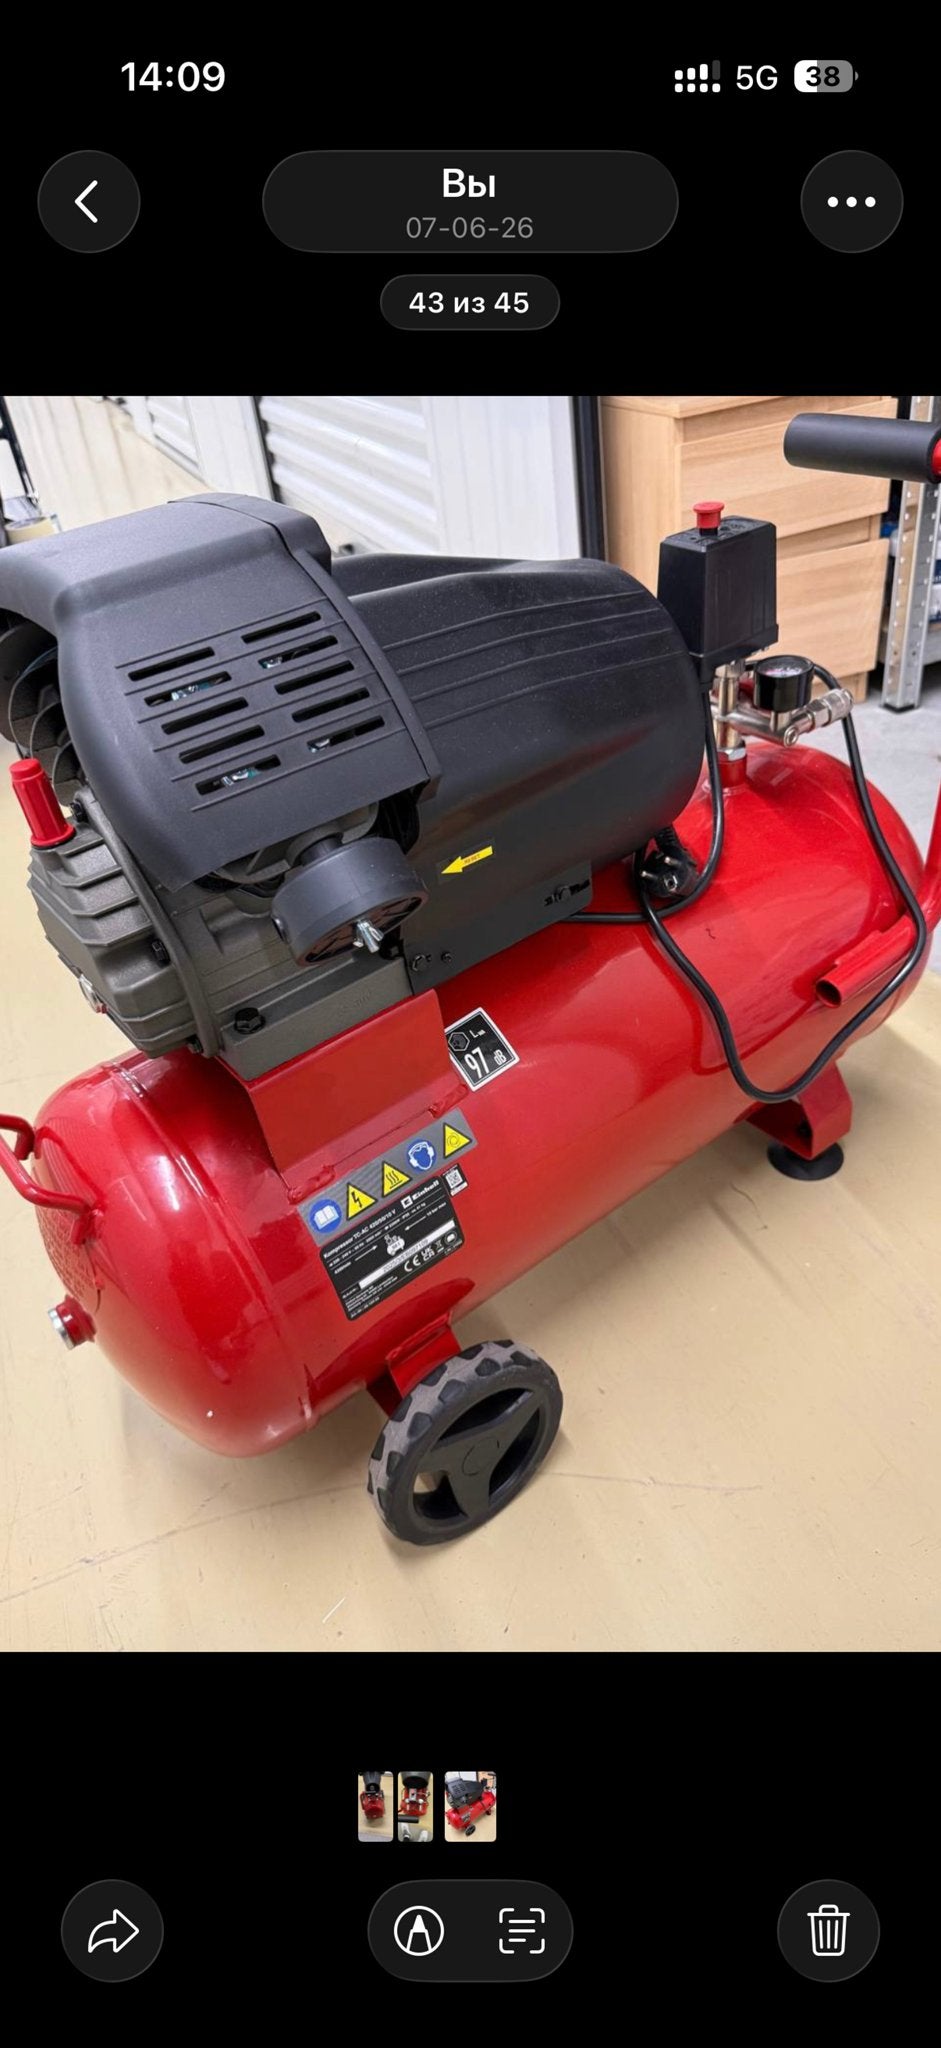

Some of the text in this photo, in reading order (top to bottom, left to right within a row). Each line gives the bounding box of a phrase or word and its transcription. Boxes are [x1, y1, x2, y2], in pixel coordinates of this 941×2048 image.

[465, 1047, 490, 1079] 97
[493, 1049, 507, 1066] dB
[411, 1180, 439, 1200] Einhell
[323, 1236, 354, 1259] Kompressor
[403, 1254, 421, 1273] CE
